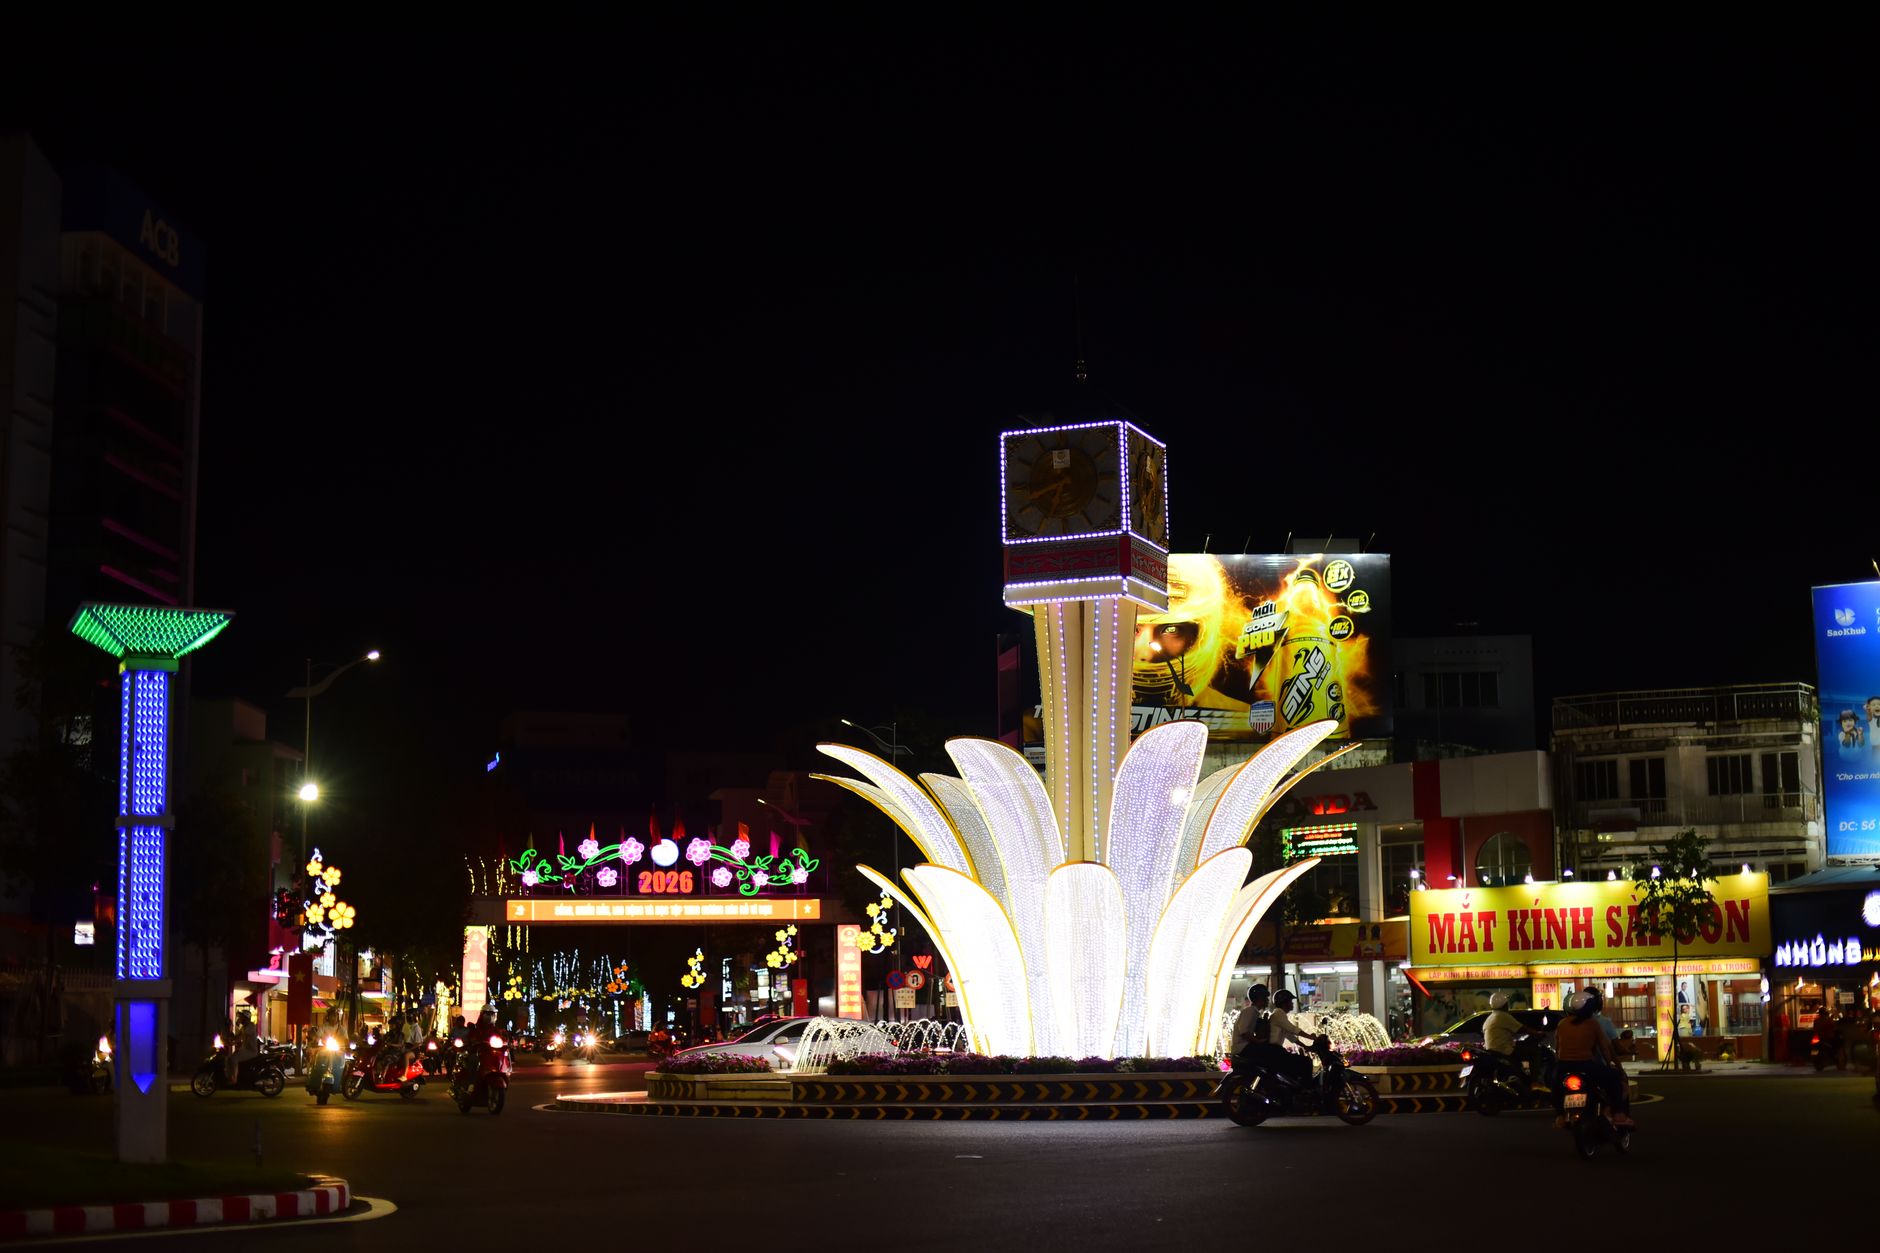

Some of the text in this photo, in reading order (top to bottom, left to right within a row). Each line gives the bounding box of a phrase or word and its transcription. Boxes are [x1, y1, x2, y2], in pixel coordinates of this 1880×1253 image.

[140, 208, 180, 267] ACB
[1327, 566, 1349, 584] 8X
[1246, 621, 1275, 633] GOLD
[1331, 621, 1349, 633] +10%
[1236, 631, 1275, 659] PRO
[1282, 648, 1325, 722] STING
[639, 871, 693, 893] 2026
[1428, 893, 1496, 954] MẮT
[1507, 898, 1595, 951] KÍNH
[1606, 894, 1662, 948] SÀI
